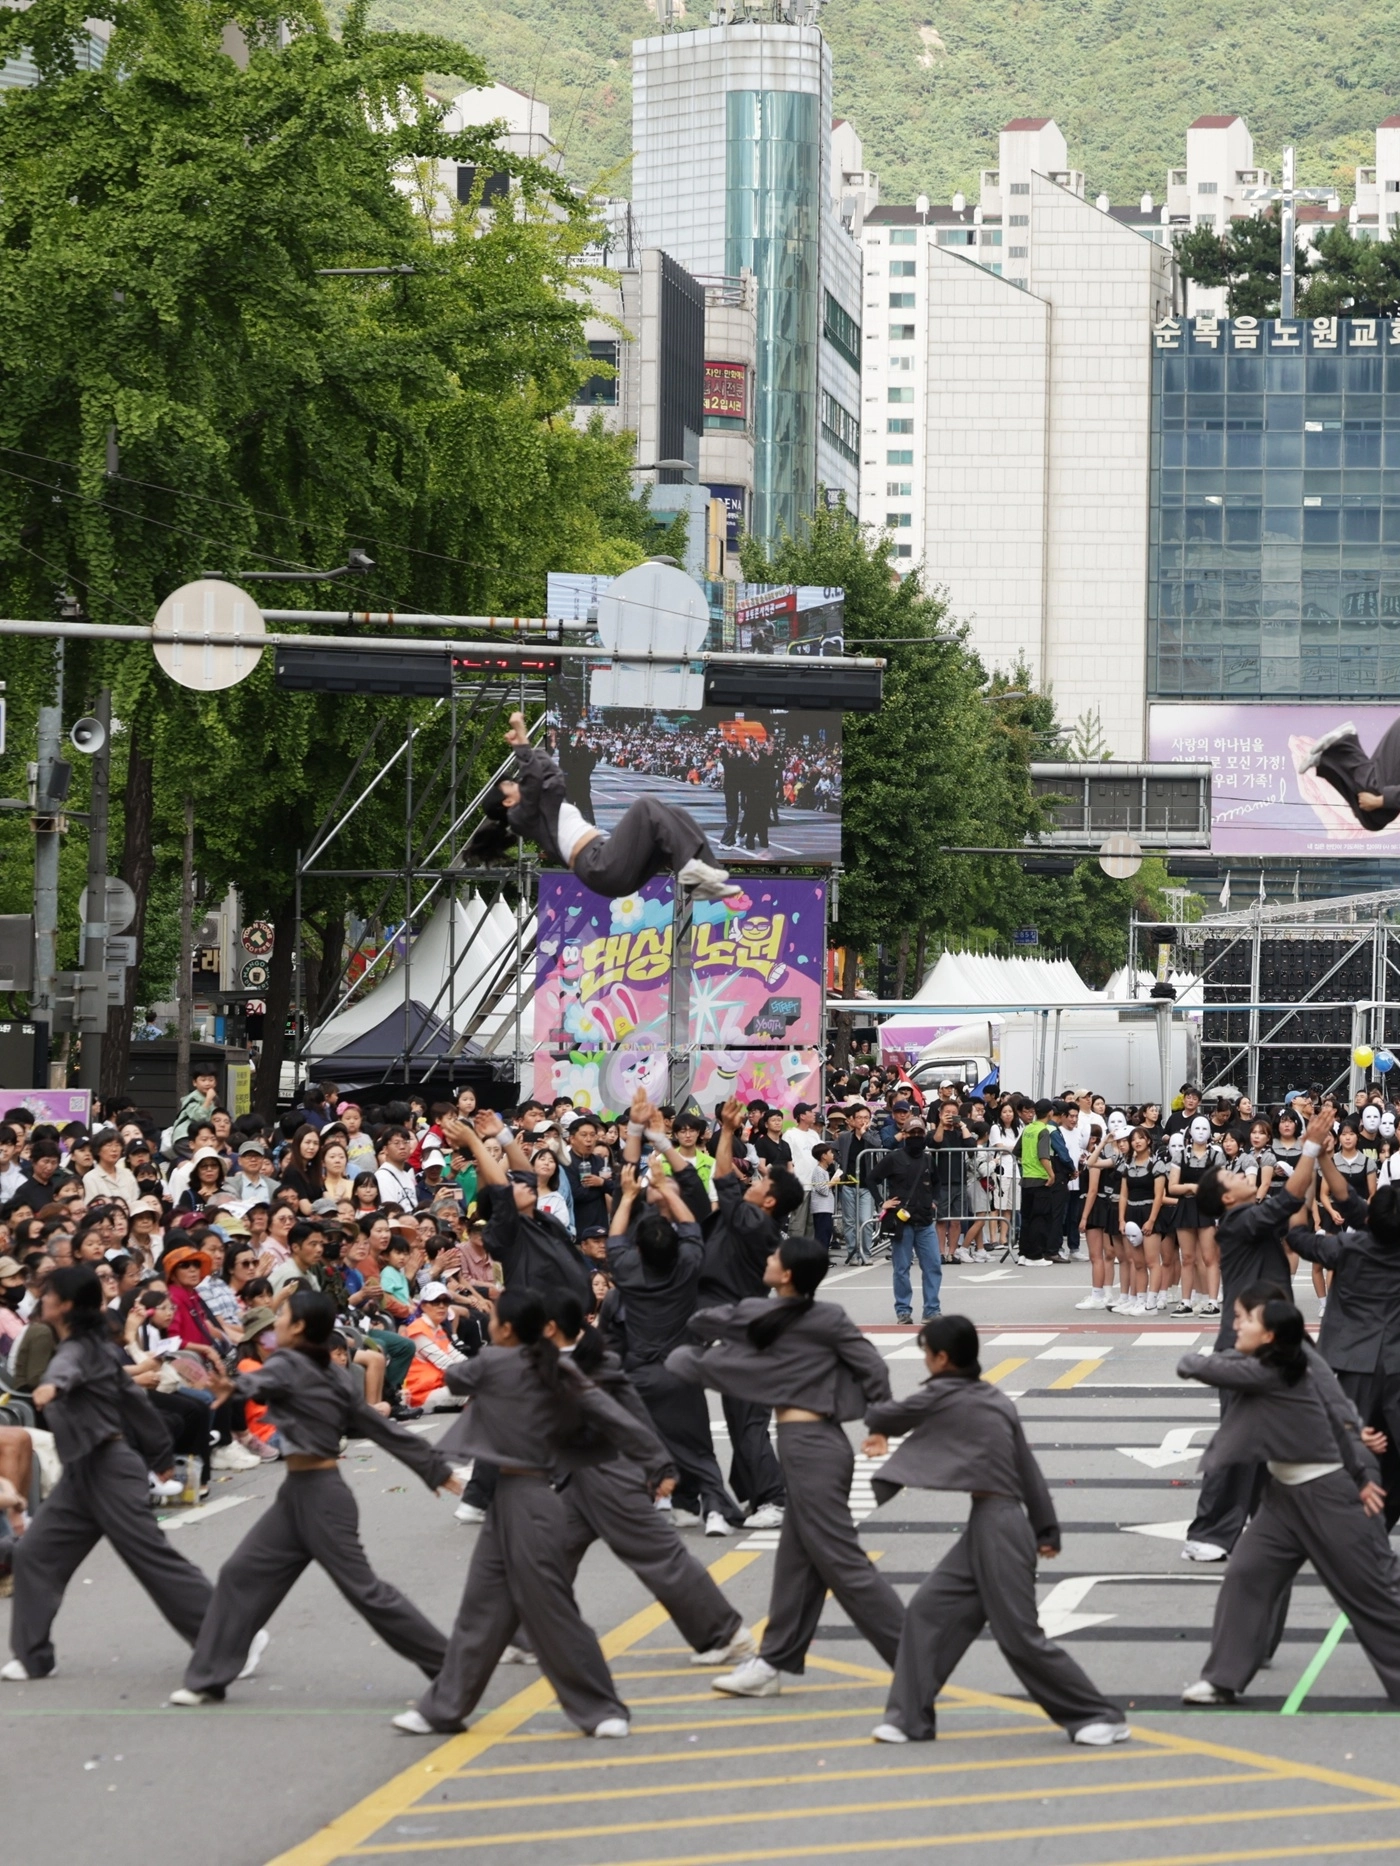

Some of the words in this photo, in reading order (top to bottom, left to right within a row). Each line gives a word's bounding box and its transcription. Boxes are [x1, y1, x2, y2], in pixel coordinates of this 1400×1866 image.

[1171, 737, 1209, 753] 사랑의
[1213, 737, 1265, 753] 하나님을
[1226, 755, 1251, 770] 모신
[1255, 755, 1286, 770] 가정!
[1213, 773, 1238, 788] 우리
[1242, 773, 1273, 788] 가족!
[244, 942, 272, 953] COFFEE
[243, 960, 265, 978] MANGO
